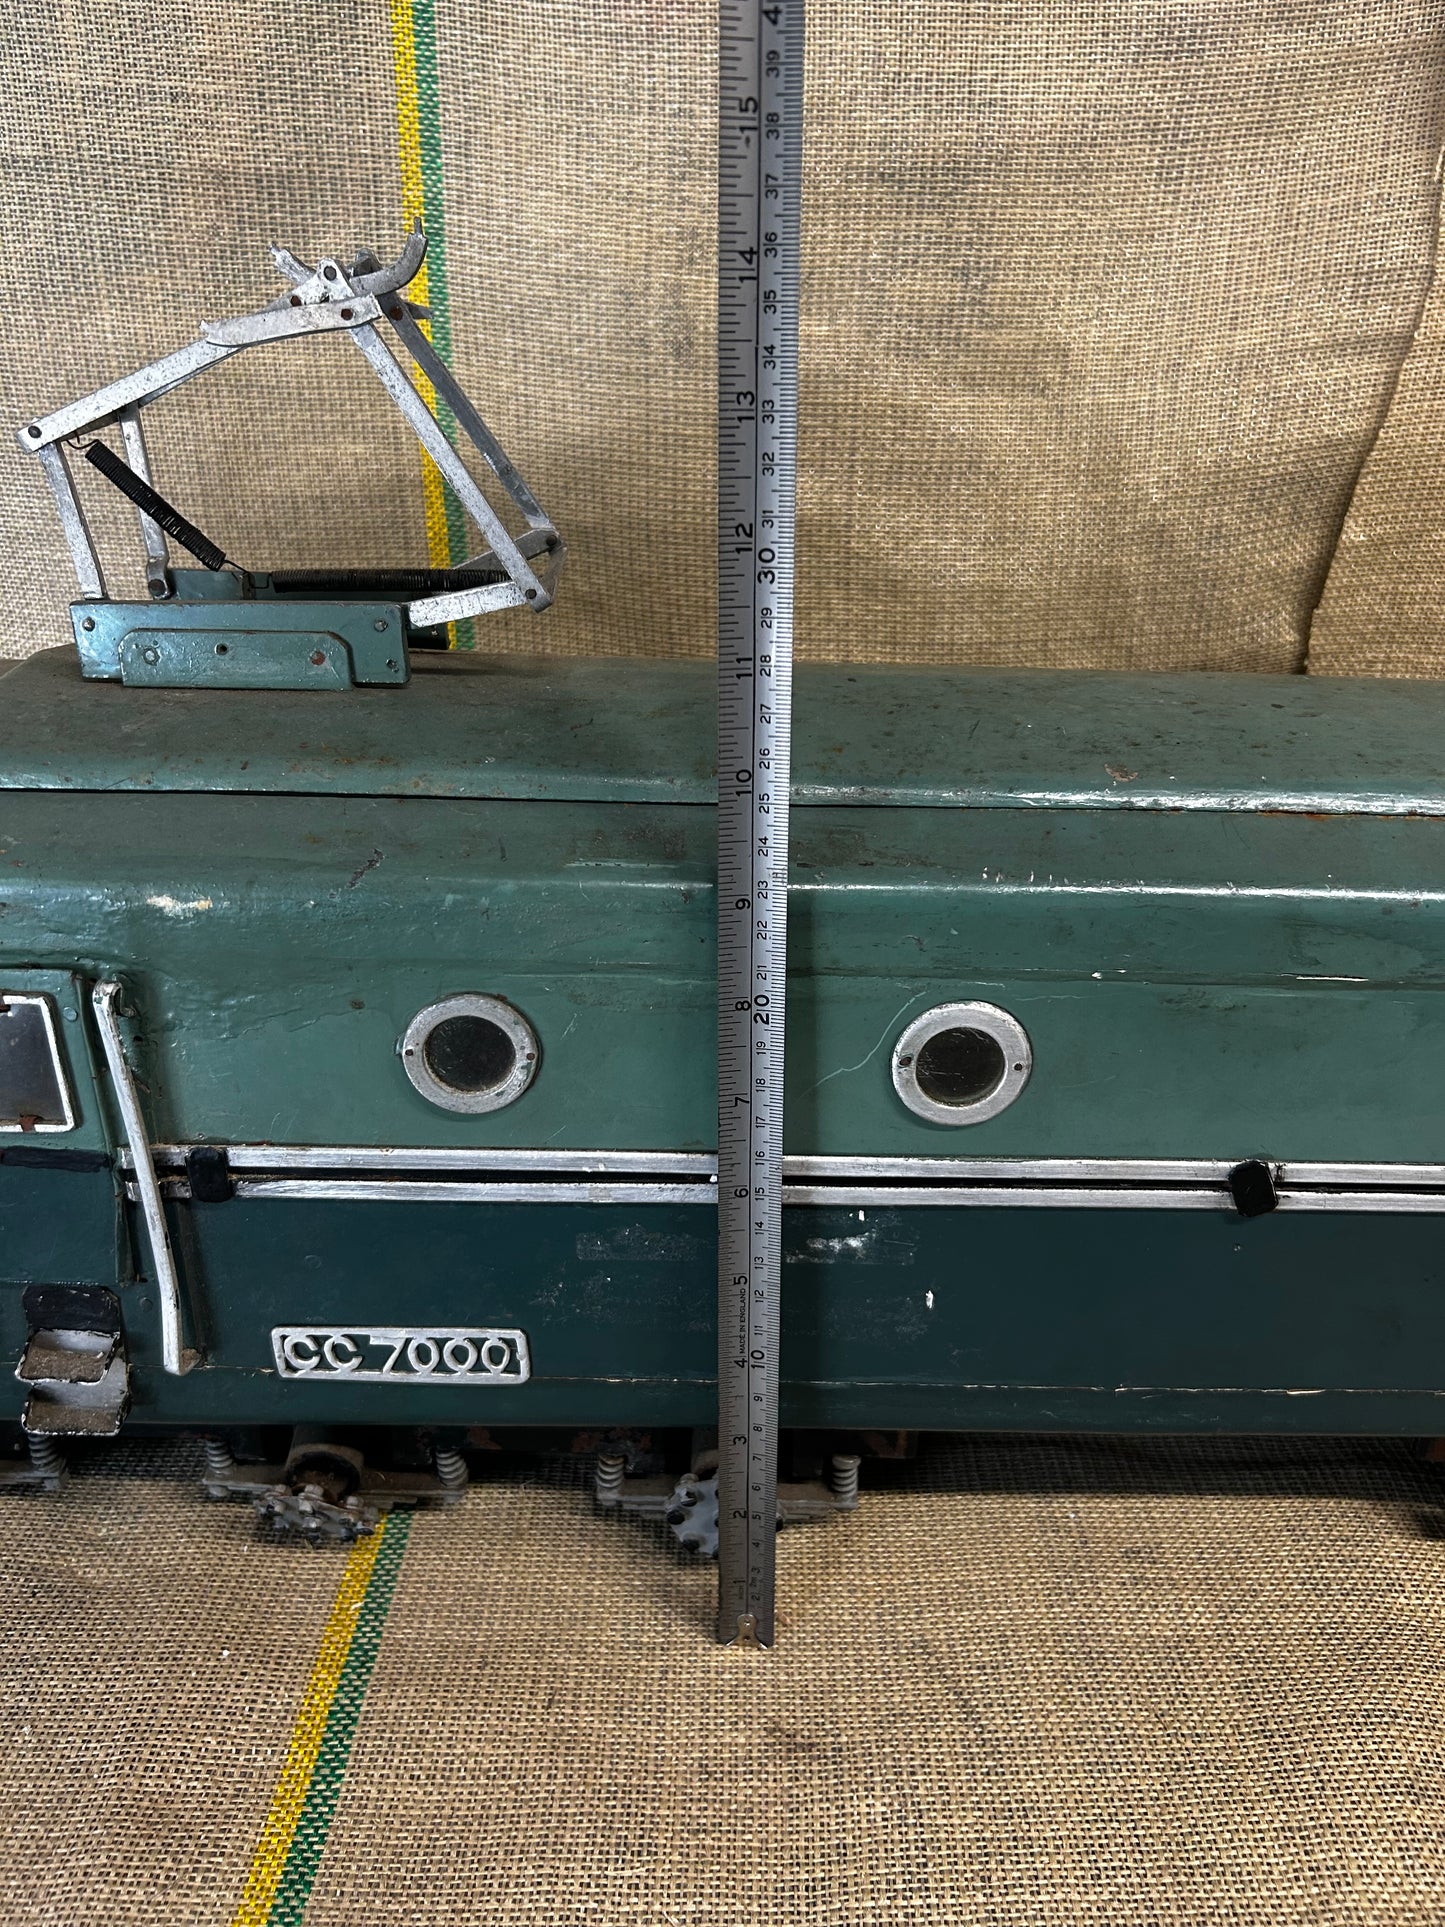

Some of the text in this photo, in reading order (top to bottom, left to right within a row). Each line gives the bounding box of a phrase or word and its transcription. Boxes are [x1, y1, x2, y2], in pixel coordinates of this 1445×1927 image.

[762, 6, 782, 26] 4
[766, 50, 780, 78] 39
[739, 97, 758, 134] 15
[766, 112, 780, 140] 38
[765, 173, 779, 200] 37
[764, 232, 777, 258] 36
[738, 247, 758, 283] 14
[764, 289, 777, 315] 35
[763, 344, 776, 370] 34
[736, 391, 755, 423] 13
[762, 399, 775, 424] 33
[762, 452, 775, 477] 32
[762, 510, 774, 528] 31
[735, 523, 753, 554] 12
[757, 547, 776, 584] 30
[761, 607, 772, 629] 29
[736, 657, 752, 680] 11
[760, 654, 771, 677] 28
[760, 703, 771, 724] 27
[759, 748, 770, 769] 26
[735, 769, 752, 797] 10
[759, 793, 769, 814] 25
[758, 836, 769, 857] 24
[757, 880, 768, 899] 23
[735, 898, 751, 910] 9
[757, 920, 767, 940] 22
[757, 965, 767, 981] 21
[735, 1000, 752, 1011] 8
[753, 994, 769, 1025] 20
[756, 1041, 766, 1055] 19
[755, 1078, 766, 1092] 18
[735, 1097, 749, 1107] 7
[755, 1116, 766, 1128] 17
[755, 1150, 765, 1166] 16
[734, 1188, 749, 1198] 6
[755, 1187, 765, 1201] 15
[755, 1221, 764, 1235] 14
[754, 1256, 764, 1270] 13
[733, 1275, 748, 1285] 5
[754, 1289, 764, 1303] 12
[754, 1325, 763, 1336] 11
[284, 1334, 511, 1375] CC 7000
[734, 1358, 748, 1369] 4
[751, 1350, 765, 1369] 10
[733, 1435, 747, 1445] 3
[733, 1510, 747, 1518] 2
